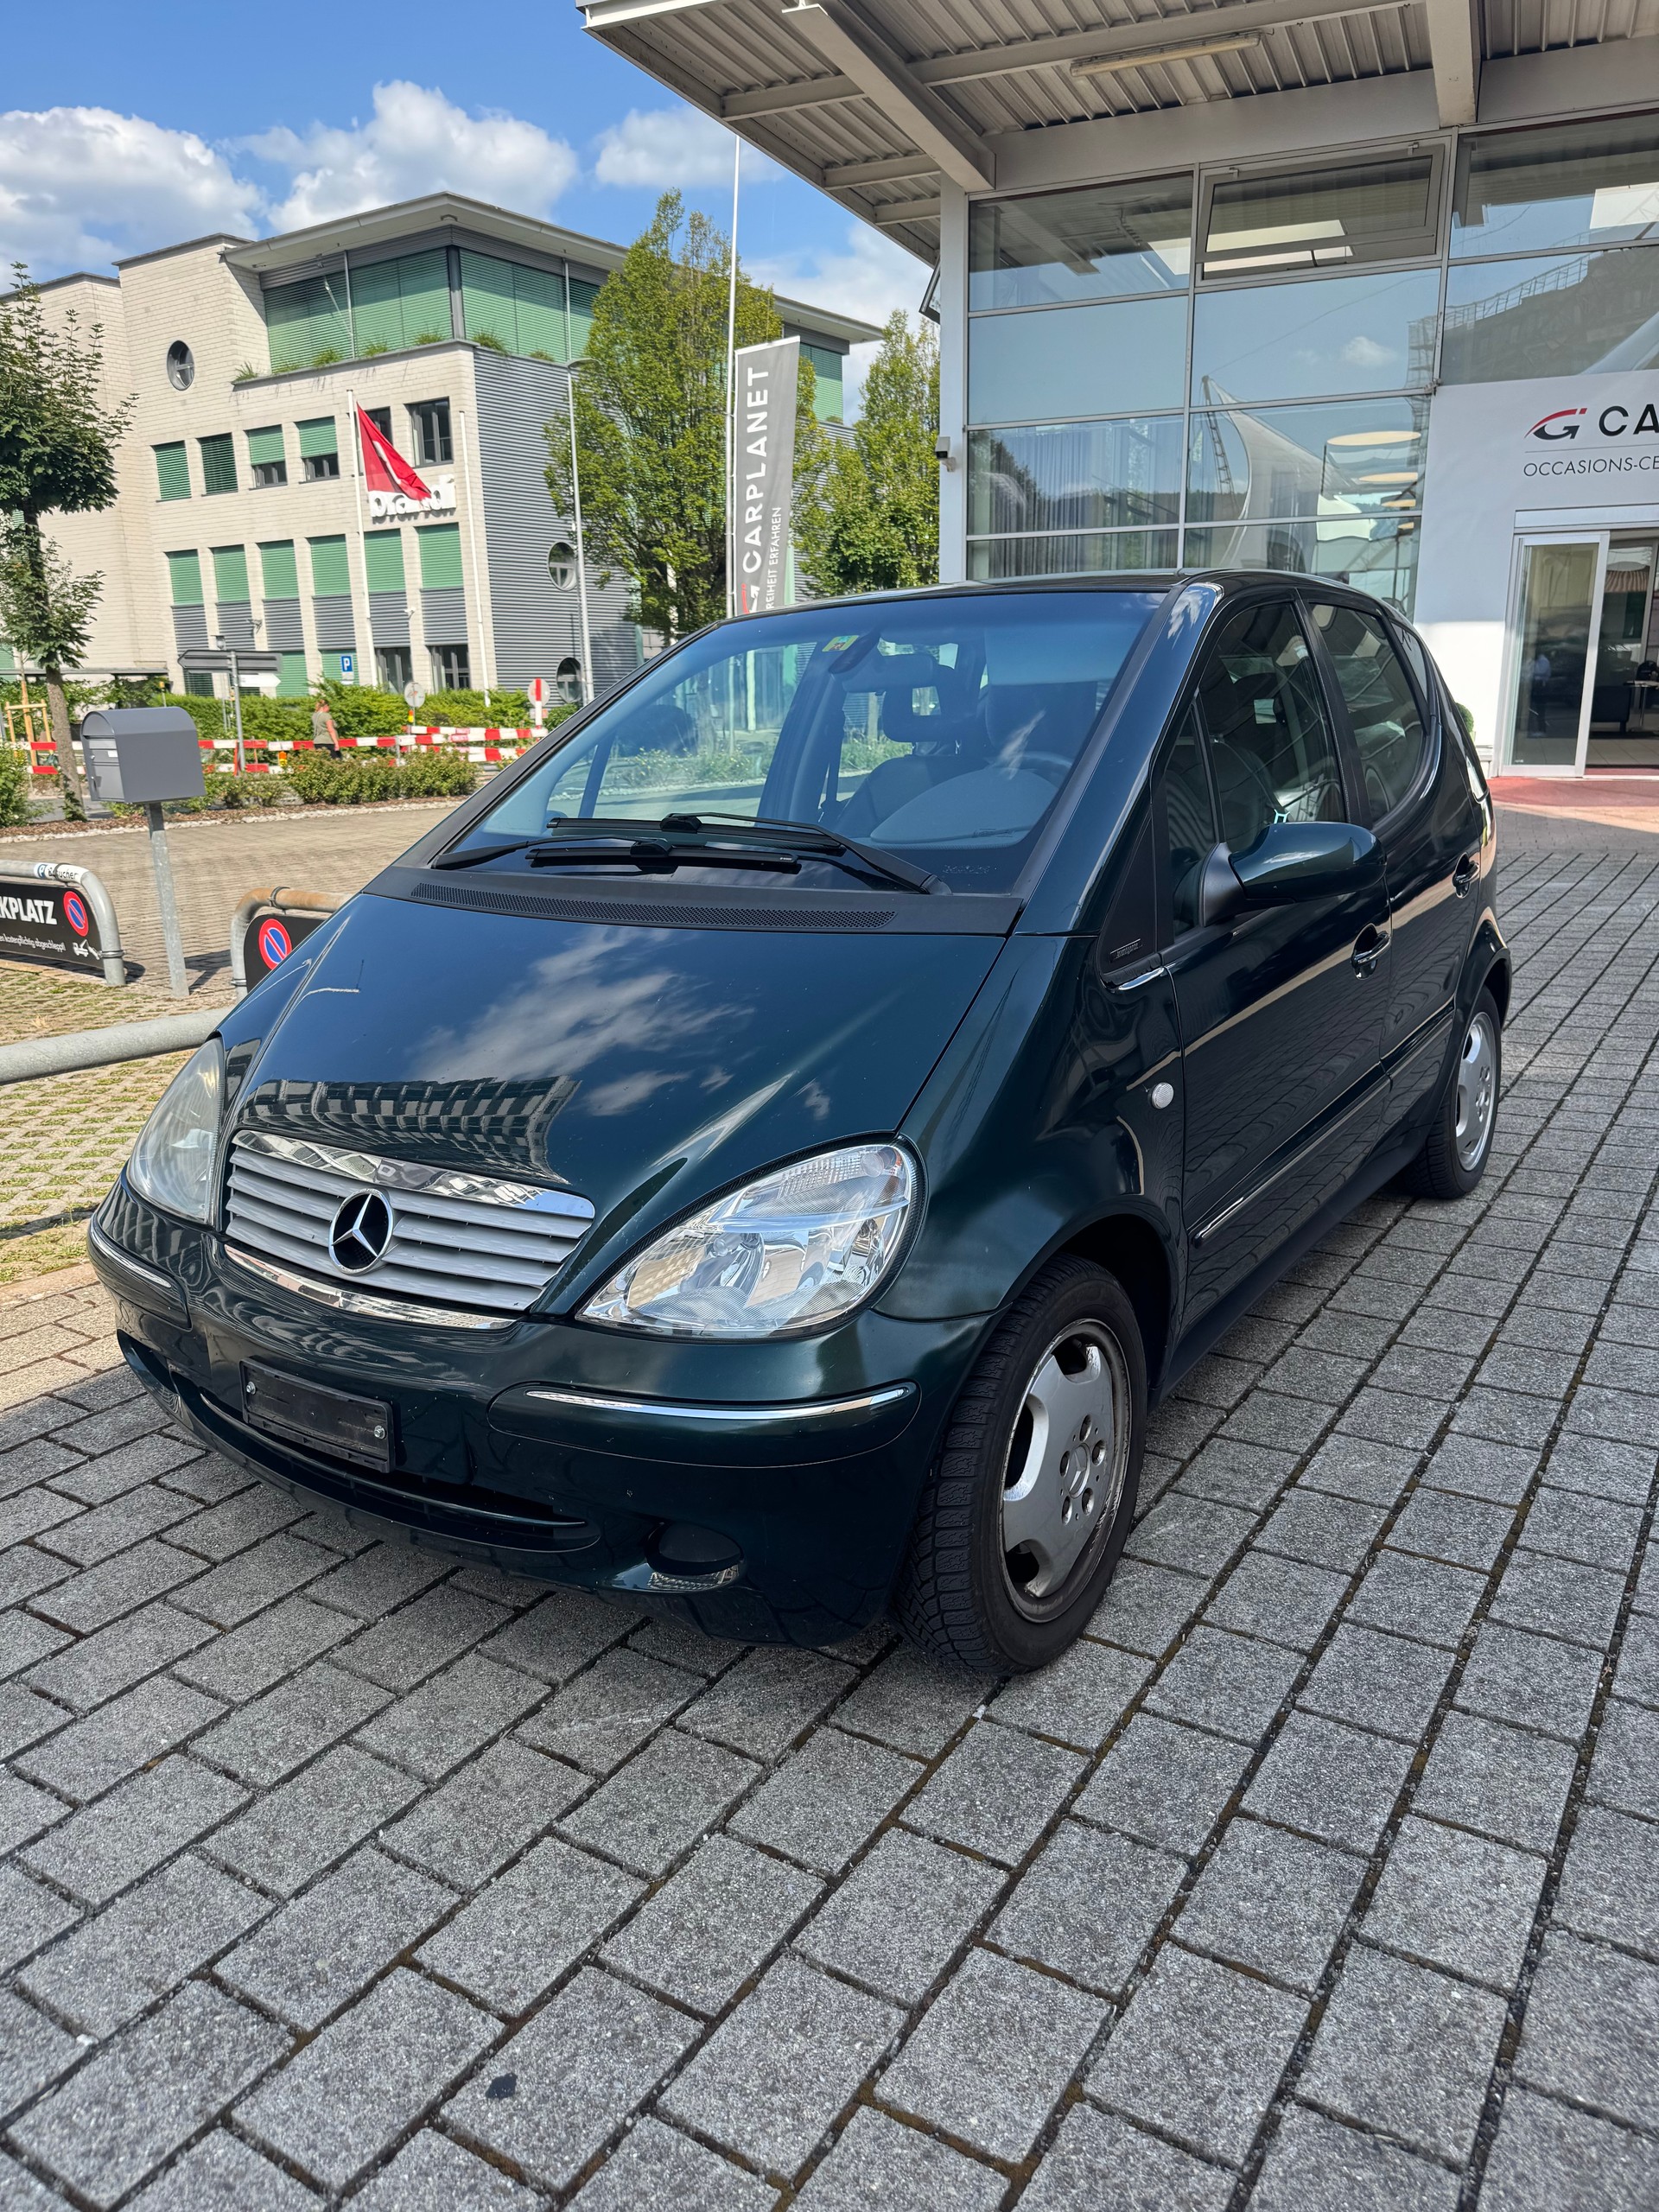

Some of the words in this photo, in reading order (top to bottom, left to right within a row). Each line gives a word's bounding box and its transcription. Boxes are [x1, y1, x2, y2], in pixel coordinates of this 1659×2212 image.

[1599, 404, 1659, 436] CA
[743, 367, 769, 573] CARPLANET
[1523, 455, 1659, 476] OCCASIONS-CE
[769, 507, 781, 565] ERFAHREN
[766, 569, 778, 610] REIHEIT
[0, 896, 57, 925] KPLATZ
